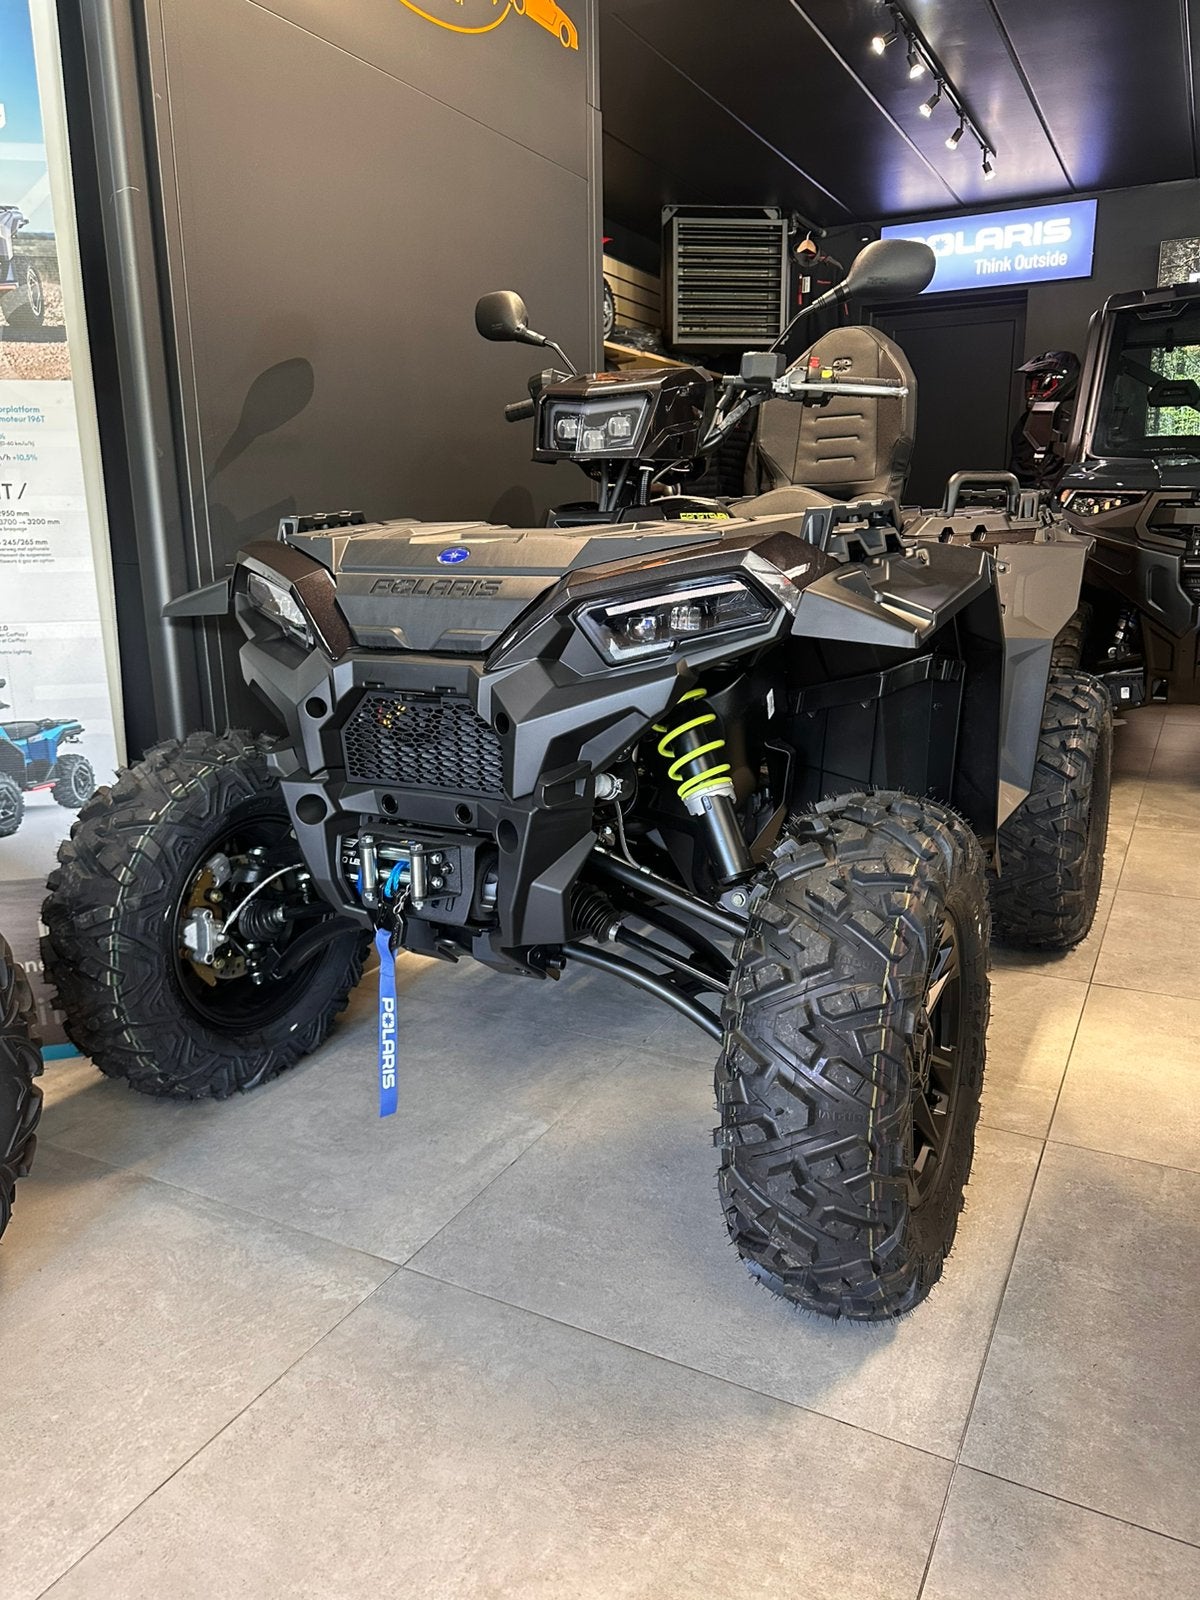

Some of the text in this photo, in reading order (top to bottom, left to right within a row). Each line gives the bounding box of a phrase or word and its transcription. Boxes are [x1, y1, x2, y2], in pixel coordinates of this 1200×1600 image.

[903, 217, 1072, 257] OLARIS
[974, 251, 1067, 275] Think Outside
[27, 415, 45, 423] 196T
[369, 578, 503, 597] POLARIS
[382, 997, 396, 1090] POLARIS
